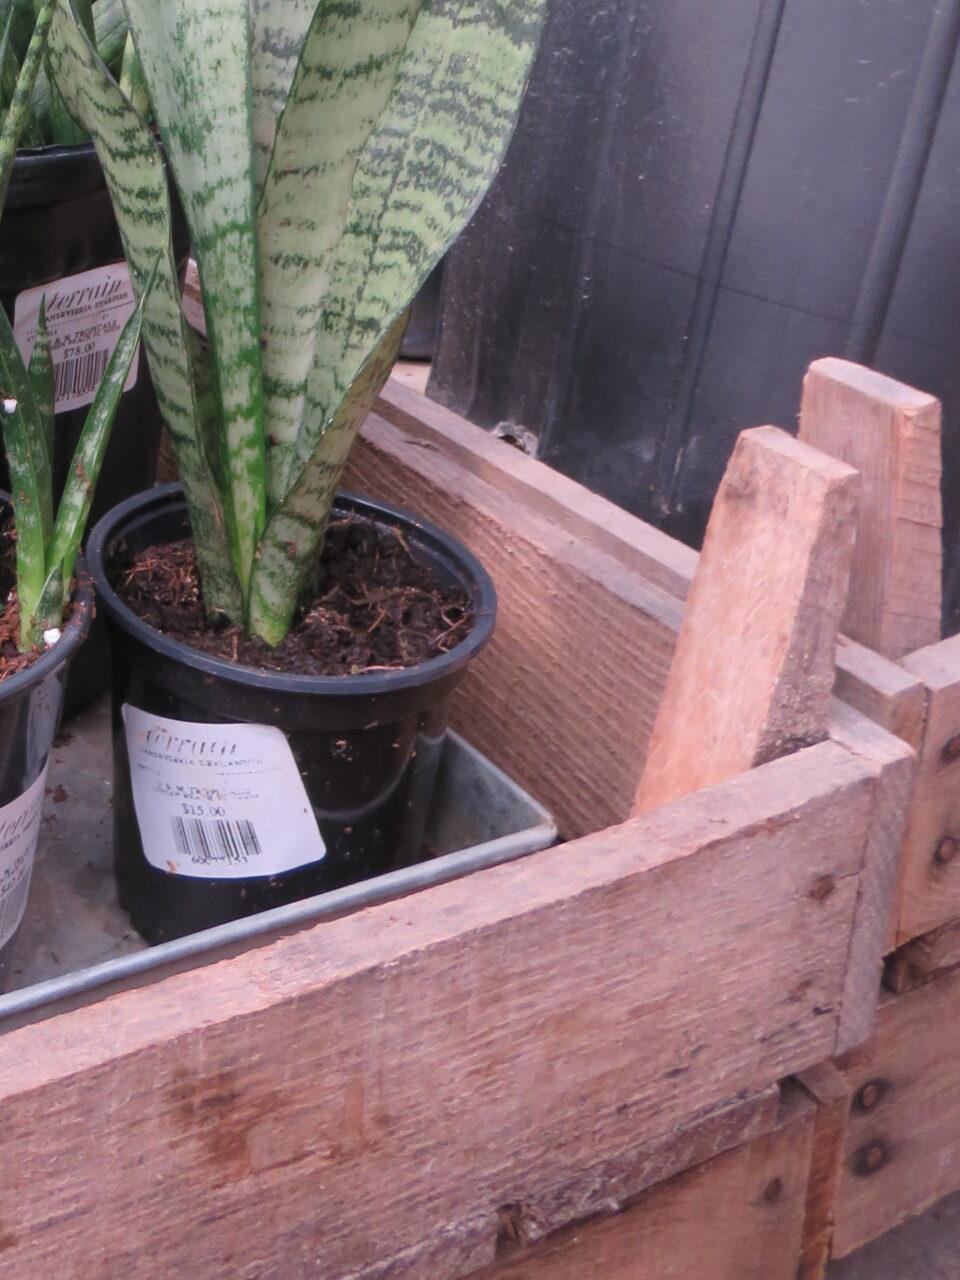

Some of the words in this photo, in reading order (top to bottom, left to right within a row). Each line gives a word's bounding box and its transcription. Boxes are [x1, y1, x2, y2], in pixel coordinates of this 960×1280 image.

[45, 306, 92, 322] ANSEVIERIA
[63, 341, 96, 360] $78.00
[181, 802, 226, 817] $15.00
